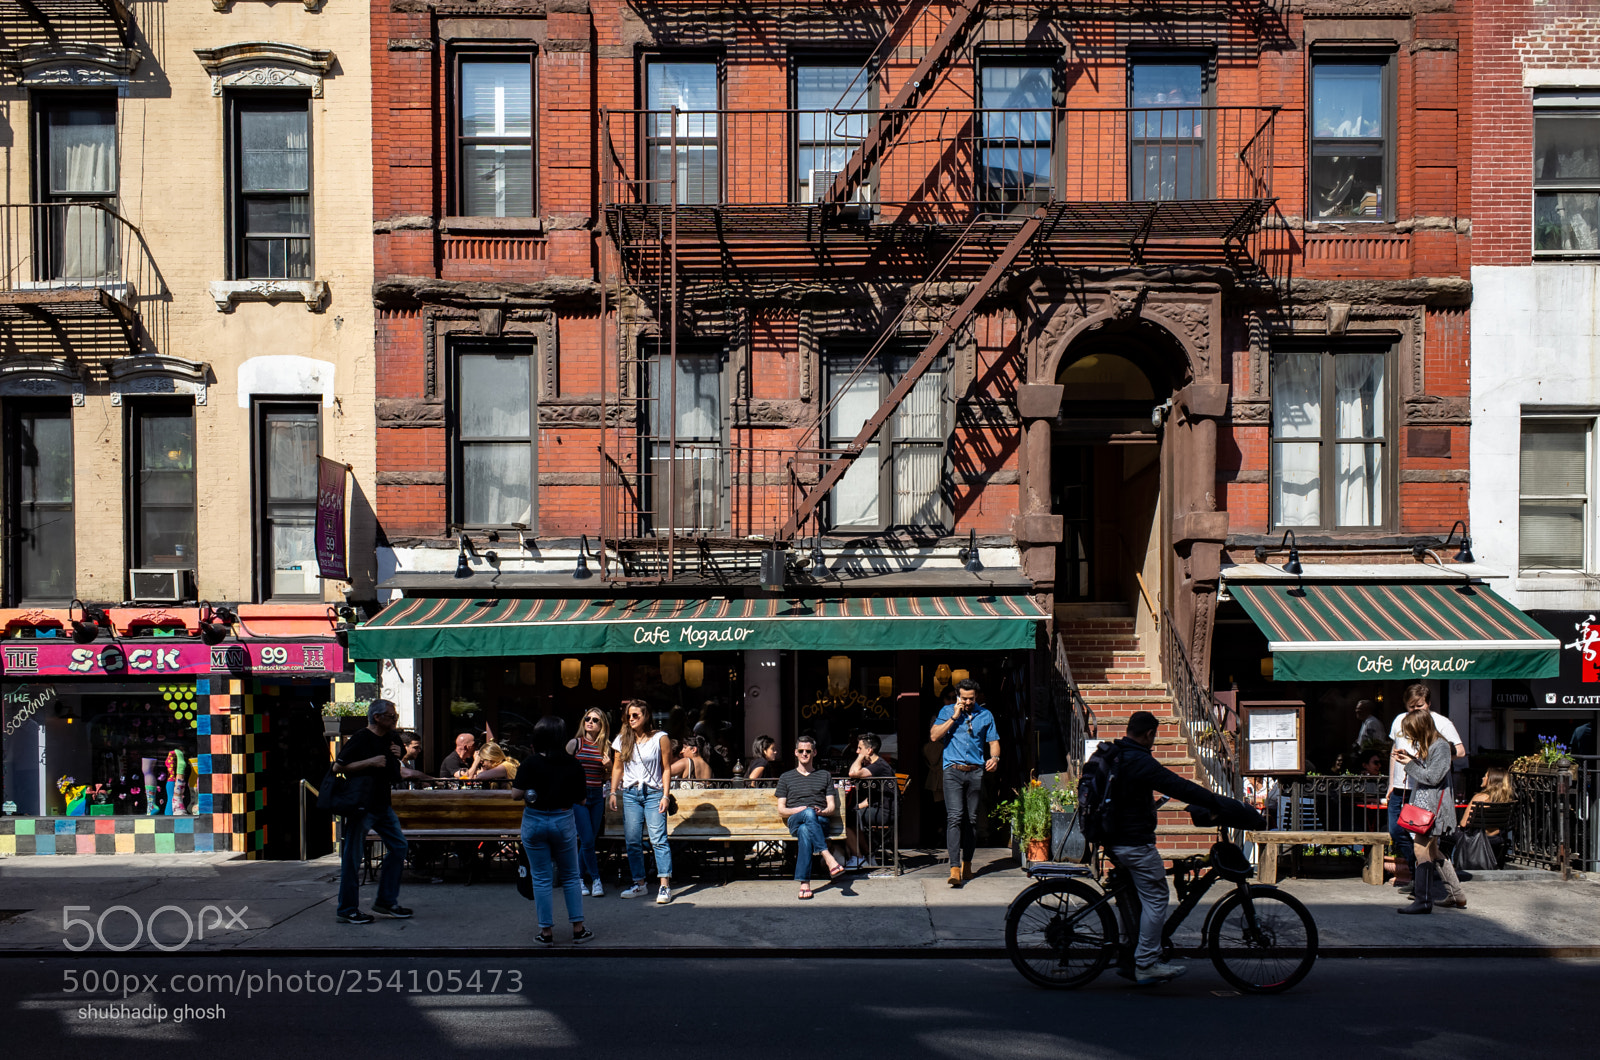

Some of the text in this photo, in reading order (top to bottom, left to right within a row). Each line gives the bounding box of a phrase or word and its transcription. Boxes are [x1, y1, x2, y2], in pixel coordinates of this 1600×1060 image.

[633, 624, 755, 649] Cafe Mogador
[5, 648, 244, 672] THE SOCK MAN
[261, 646, 288, 665] 99
[1357, 653, 1476, 677] Cafe Mogador
[1562, 695, 1576, 704] CJ.
